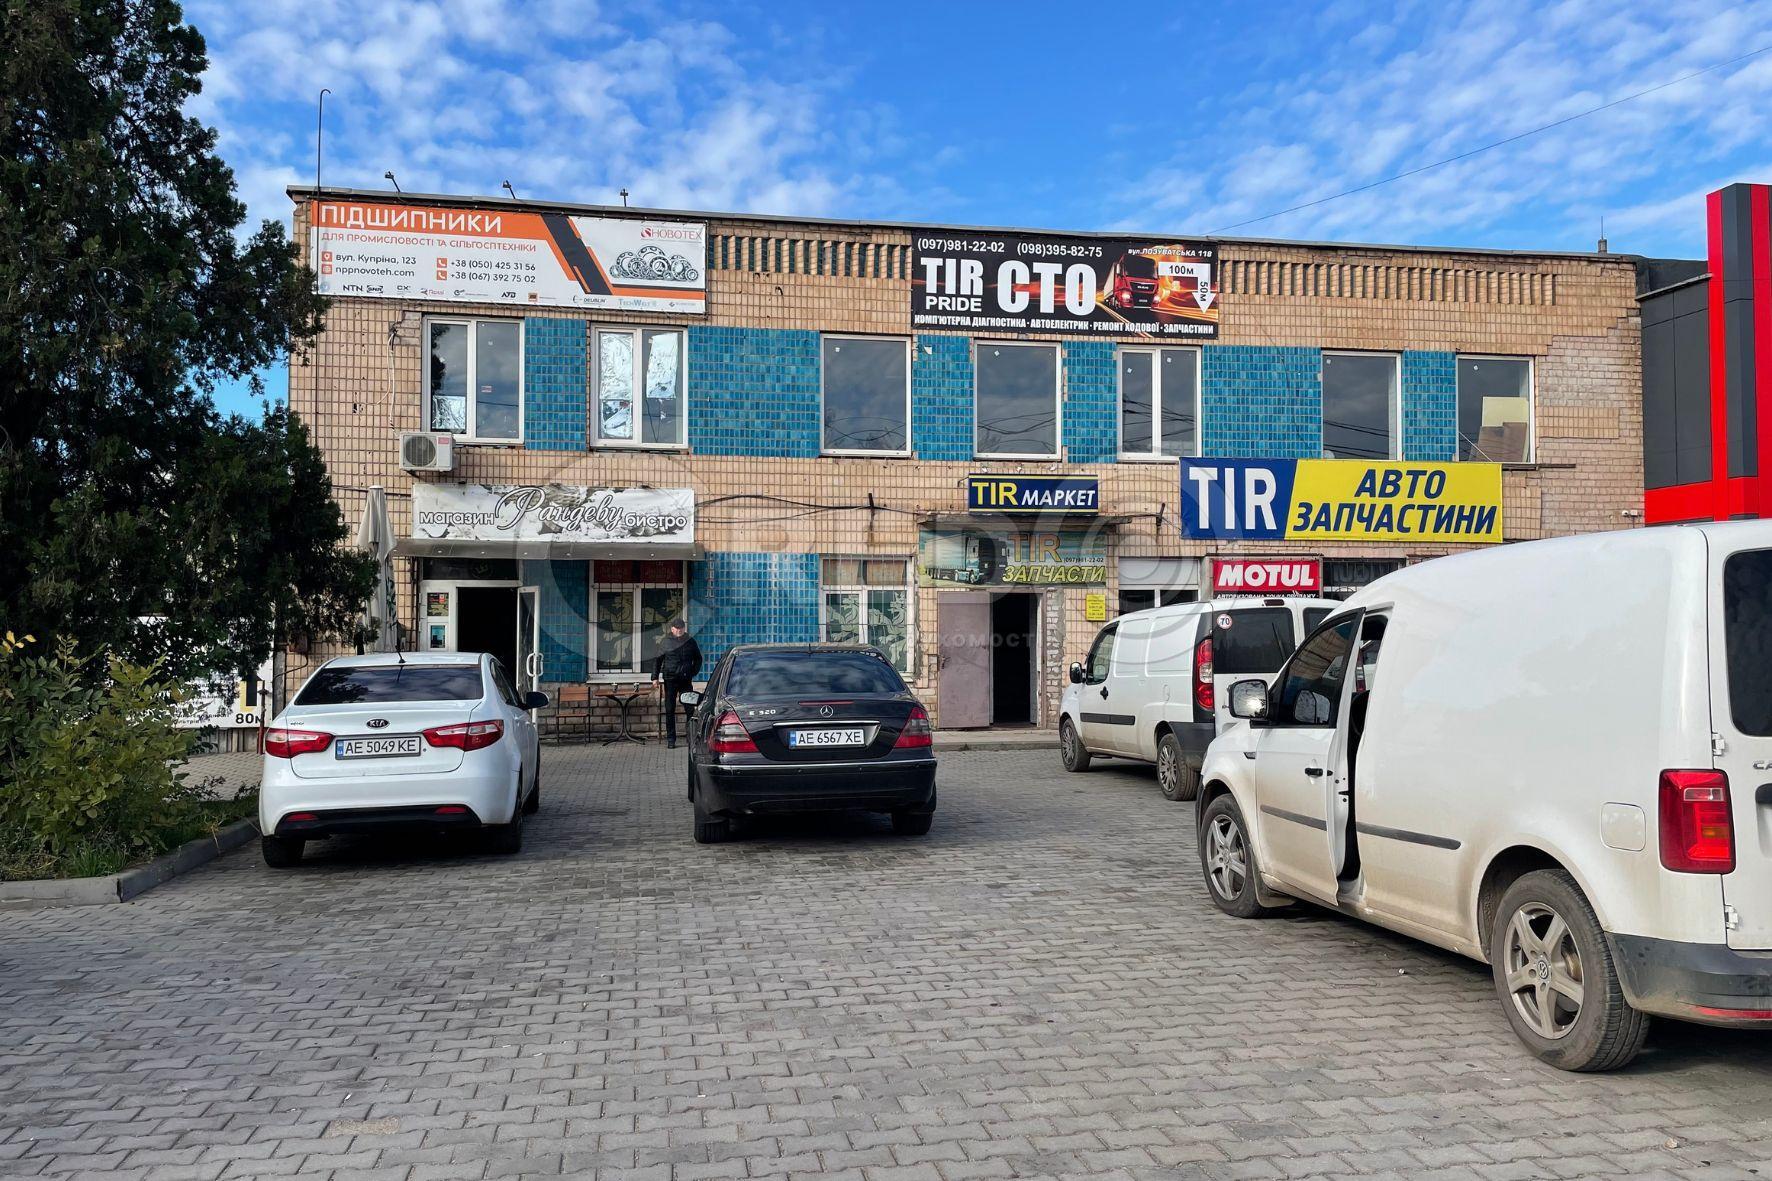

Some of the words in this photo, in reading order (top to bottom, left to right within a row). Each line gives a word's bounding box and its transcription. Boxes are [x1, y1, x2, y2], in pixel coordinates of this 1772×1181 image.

[321, 205, 502, 233] ПІДШИПНИКИ
[321, 232, 344, 241] ДЛЯ
[346, 233, 434, 246] ПРОМИСЛОВОСТІ
[437, 239, 447, 247] ТА
[449, 240, 536, 252] СІЛЬГОСПТЕХНІКИ
[917, 238, 1005, 253] (097)981-22-02
[1017, 242, 1103, 258] (098)395-82-75
[335, 254, 355, 263] вул.
[357, 254, 399, 265] Купріна,
[401, 256, 417, 265] 123
[1197, 250, 1212, 258] 118
[335, 266, 415, 277] nppnovoteh.com
[468, 260, 493, 269] (050)
[494, 261, 511, 270] 425
[513, 262, 523, 270] 31
[525, 263, 536, 271] 56
[468, 272, 491, 281] (067)
[492, 273, 509, 282] 392
[511, 274, 522, 282] 75
[524, 275, 536, 283] 02
[920, 256, 984, 296] TIR
[997, 260, 1097, 316] СТО
[342, 284, 363, 292] NTN
[925, 295, 982, 312] PRIDE
[971, 317, 1026, 328] ДІАГНОСТИКА
[1030, 318, 1089, 330] АВТОЕЛЕКТРИК
[1093, 321, 1124, 331] РЕМОНТ
[1124, 321, 1160, 334] ХОДОВОЇ
[1163, 323, 1214, 334] ЗАПЧАСТИНИ
[1354, 469, 1447, 499] АВТО
[971, 482, 1018, 505] TIR
[1021, 489, 1096, 506] МАРКЕТ
[1189, 467, 1277, 530] TIR
[419, 511, 494, 525] магазин
[494, 487, 624, 531] Рандеву
[625, 512, 688, 530] бистро
[1293, 502, 1497, 535] ЗАПЧАСТИНИ
[1008, 534, 1062, 562] TIR
[1002, 565, 1106, 582] ЗАПЧАСТИ
[1218, 564, 1315, 587] MOTUL
[1220, 617, 1230, 625] 70
[798, 733, 814, 744] AE
[816, 732, 841, 743] 6567
[845, 731, 861, 743] XE
[345, 741, 364, 754] AE
[366, 740, 396, 753] 5049
[397, 739, 416, 752] KE
